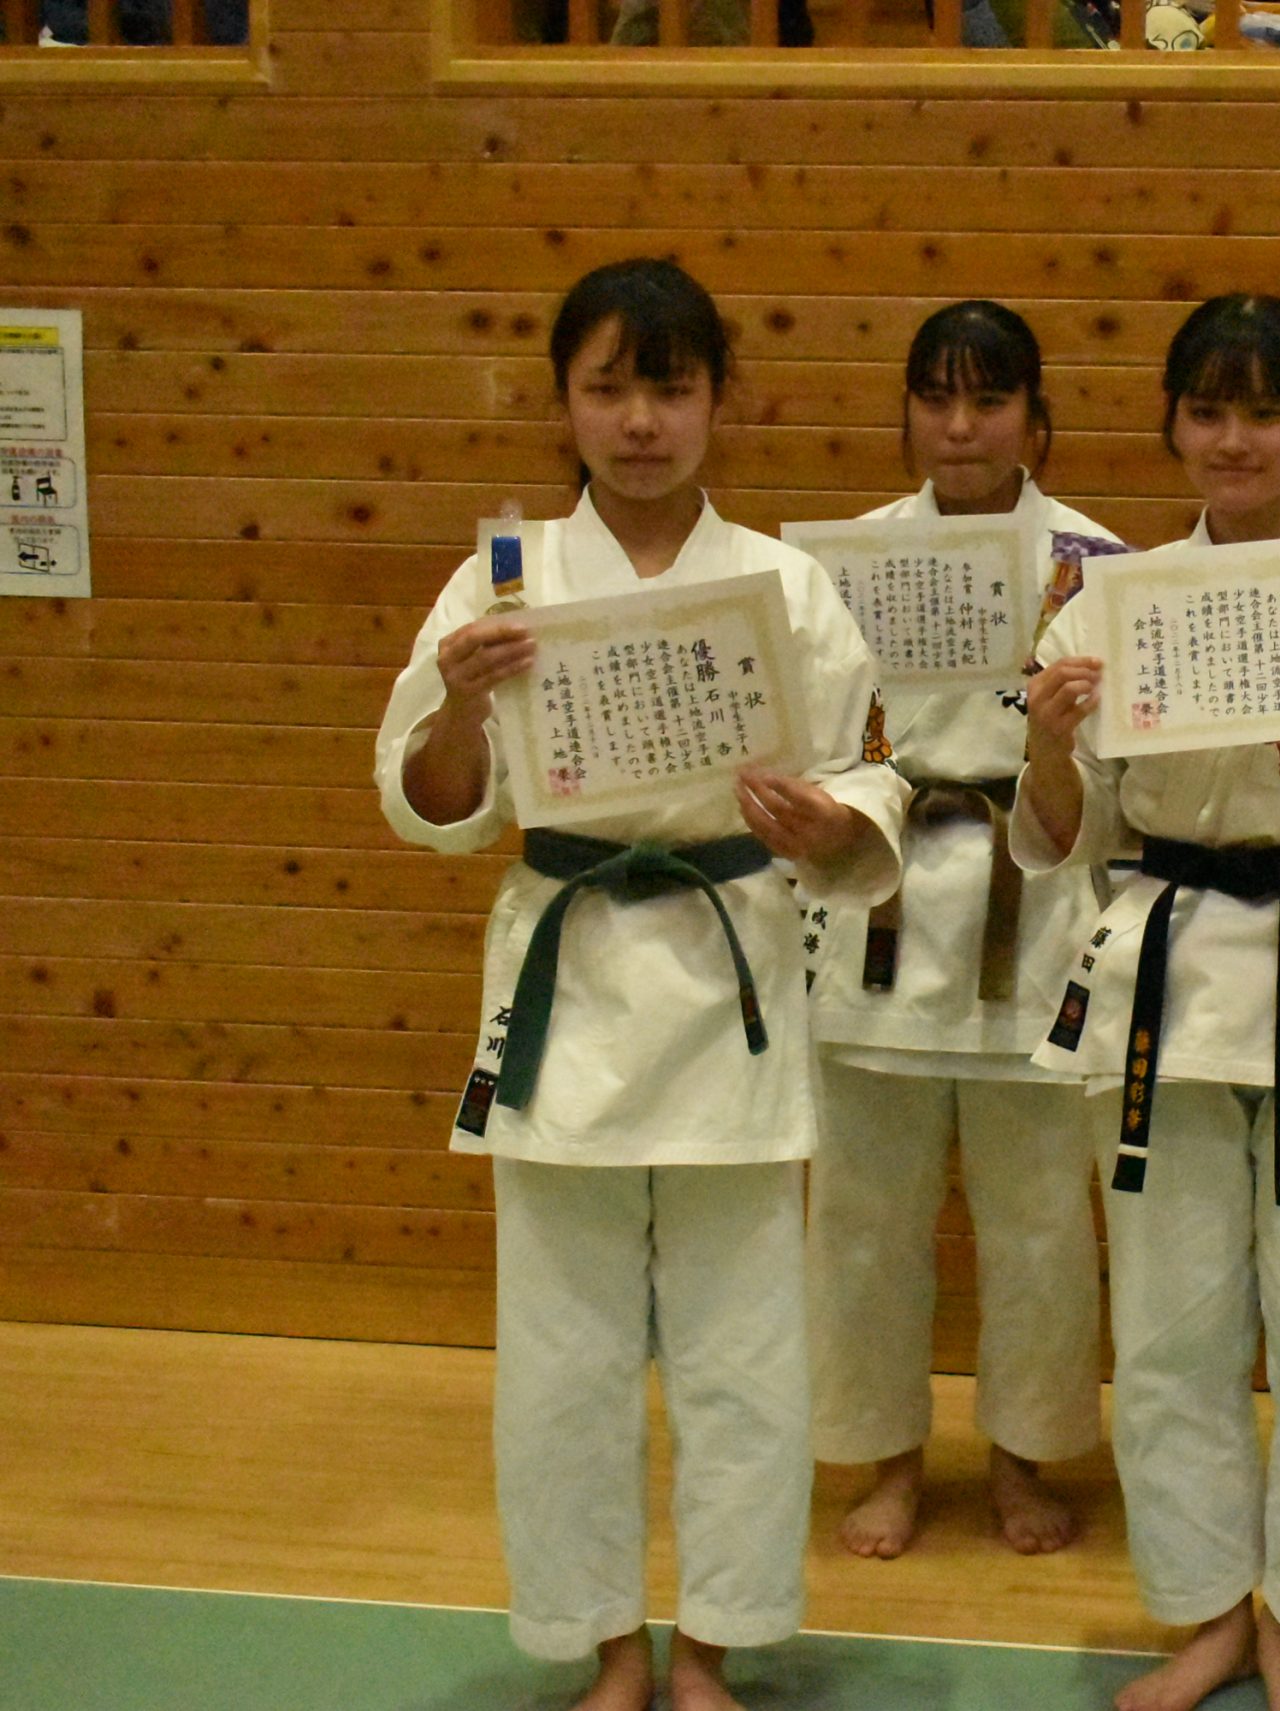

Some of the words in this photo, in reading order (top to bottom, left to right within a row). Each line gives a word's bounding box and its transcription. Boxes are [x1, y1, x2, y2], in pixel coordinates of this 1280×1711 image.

[990, 581, 1008, 626] 賞状
[691, 639, 720, 682] 優勝
[738, 657, 766, 709] 賞状
[1148, 604, 1169, 715] 上地流空手道連合会
